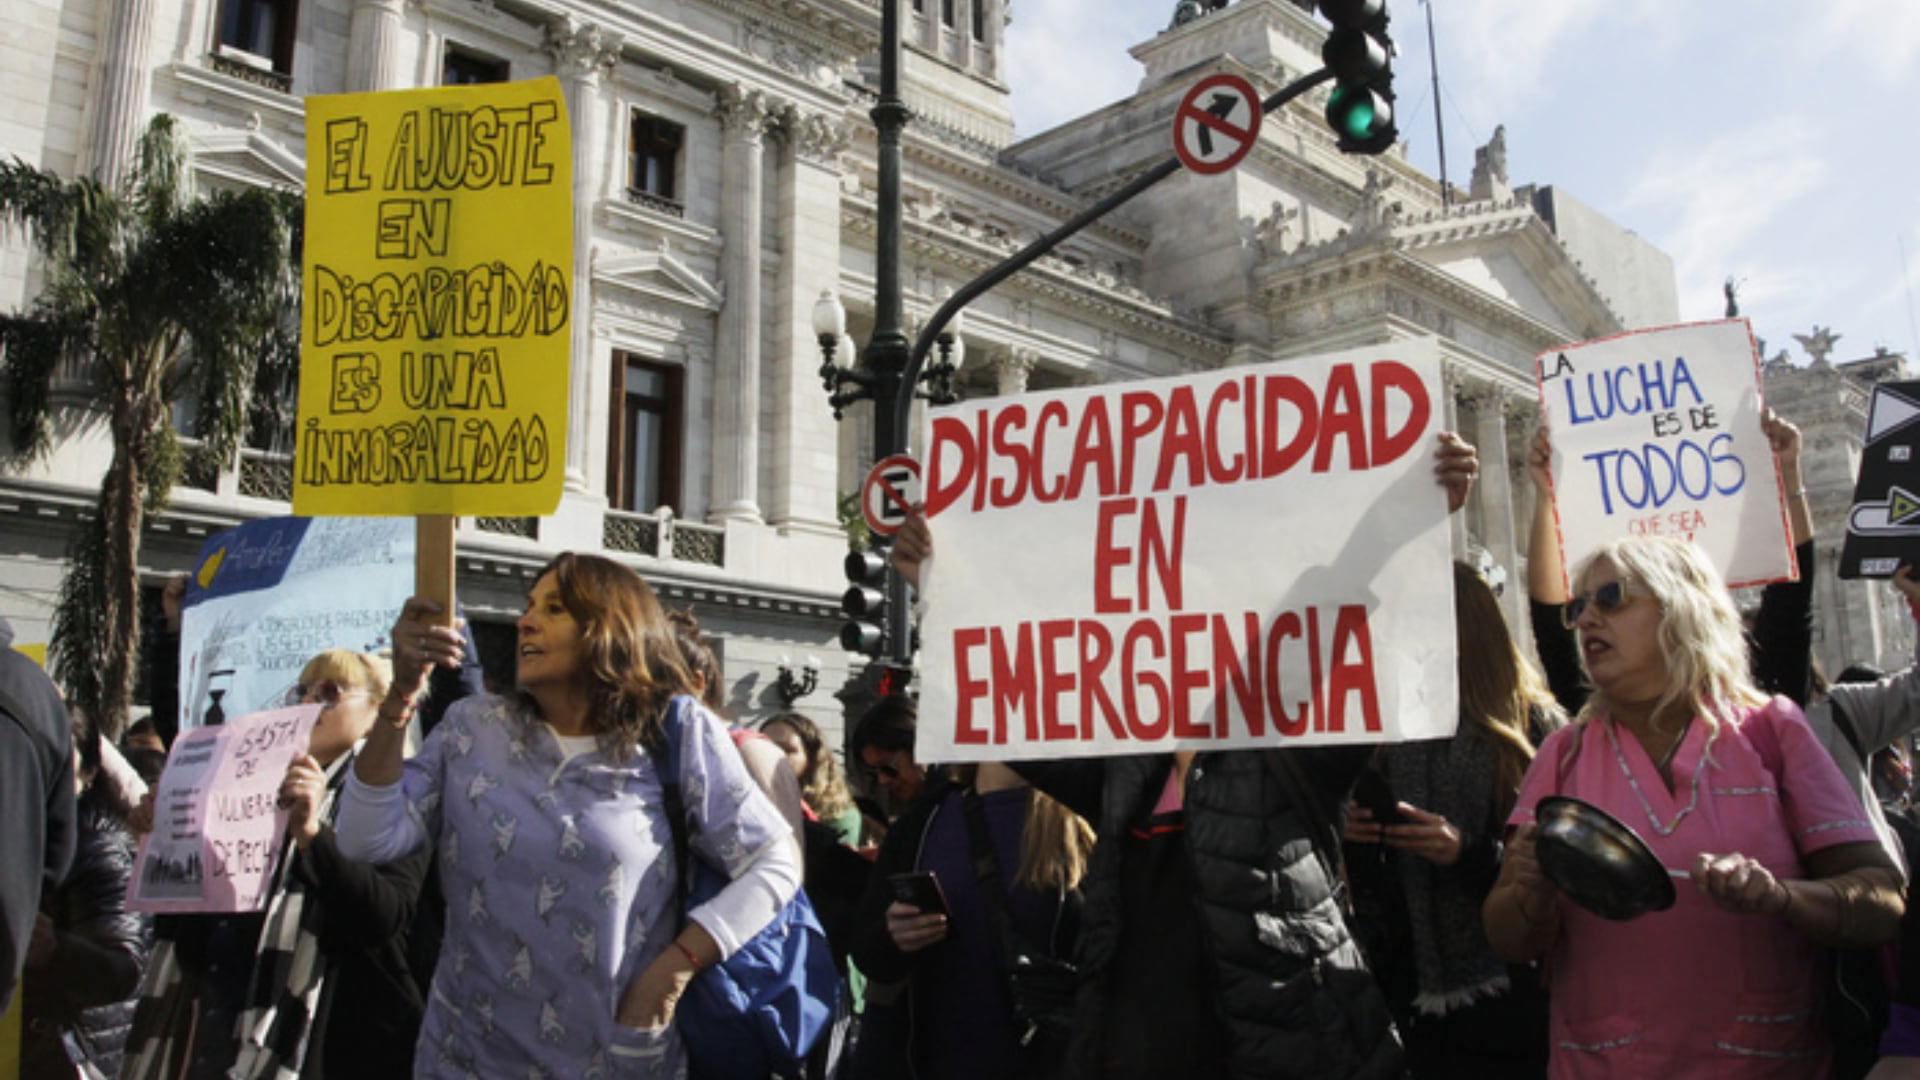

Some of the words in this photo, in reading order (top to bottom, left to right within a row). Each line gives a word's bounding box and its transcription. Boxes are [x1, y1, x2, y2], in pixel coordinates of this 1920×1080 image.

[325, 117, 370, 194] EL
[383, 101, 558, 191] AJUSTE
[375, 198, 451, 259] EN
[329, 353, 381, 414] ES
[400, 347, 506, 410] UNA
[1539, 353, 1575, 382] LA
[1565, 356, 1703, 425] LUCHA
[926, 361, 1431, 519] DISCAPACIDAD
[1653, 412, 1682, 437] ES
[1690, 405, 1719, 431] DE
[882, 472, 909, 519] E
[1583, 433, 1745, 515] TODOS
[1627, 515, 1663, 537] QUE
[1668, 508, 1706, 532] SEA
[1095, 496, 1187, 614] EN
[954, 604, 1382, 745] EMERGENCIA
[235, 718, 300, 758] BASTA
[235, 758, 259, 779] DE
[214, 793, 275, 822] VULNERA
[213, 840, 277, 877] DERECH
